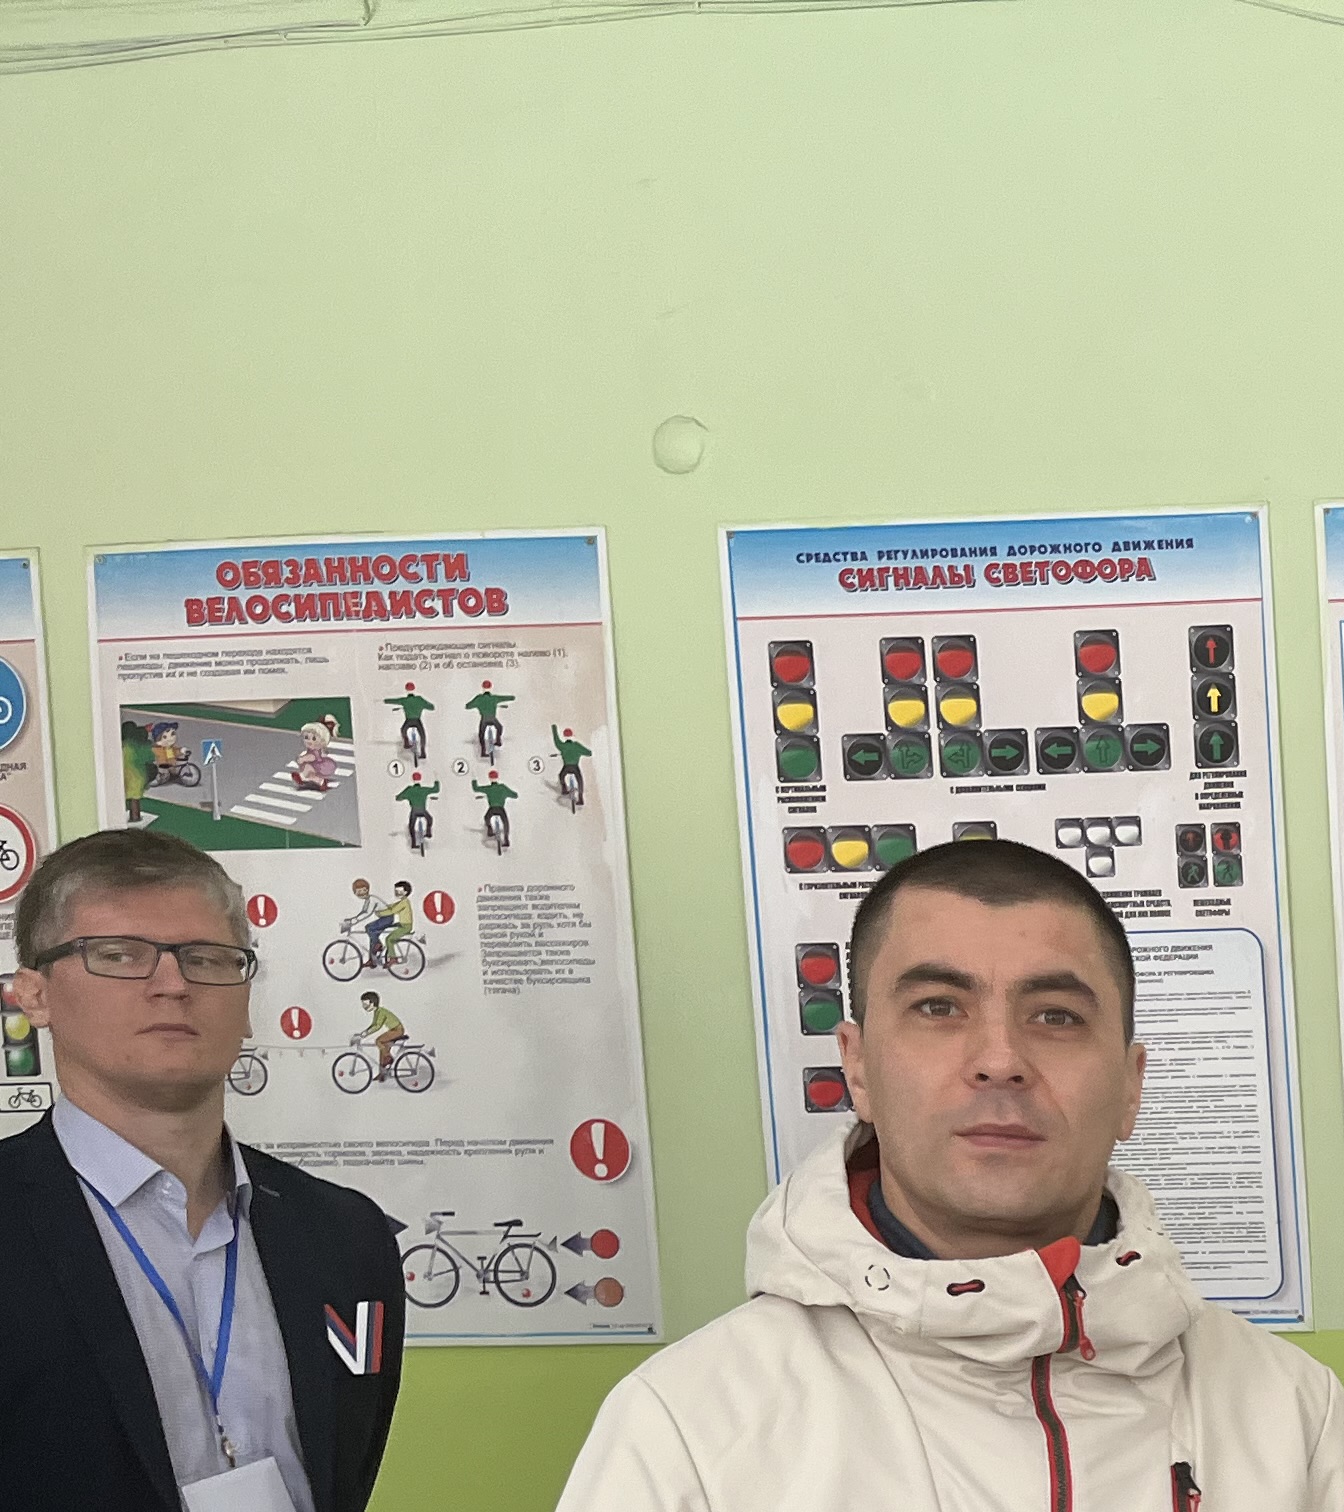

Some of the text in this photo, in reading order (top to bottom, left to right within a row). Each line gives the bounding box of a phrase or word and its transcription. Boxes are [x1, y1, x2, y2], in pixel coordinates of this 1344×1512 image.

[796, 538, 1195, 564] СРЕДСТВА РЕГУЛИРОВАНИЯ ДОРОЖНОГО ДВИЖЕНИЯ
[215, 552, 472, 591] ОБЯЗАННОСТИ
[838, 556, 1156, 592] СИГНАЛЫ СВЕТОФОРА
[184, 587, 510, 627] ВЕЛОСИПЕДИСТОВ
[392, 763, 399, 774] 1
[457, 762, 465, 773] 2
[533, 760, 541, 771] 3
